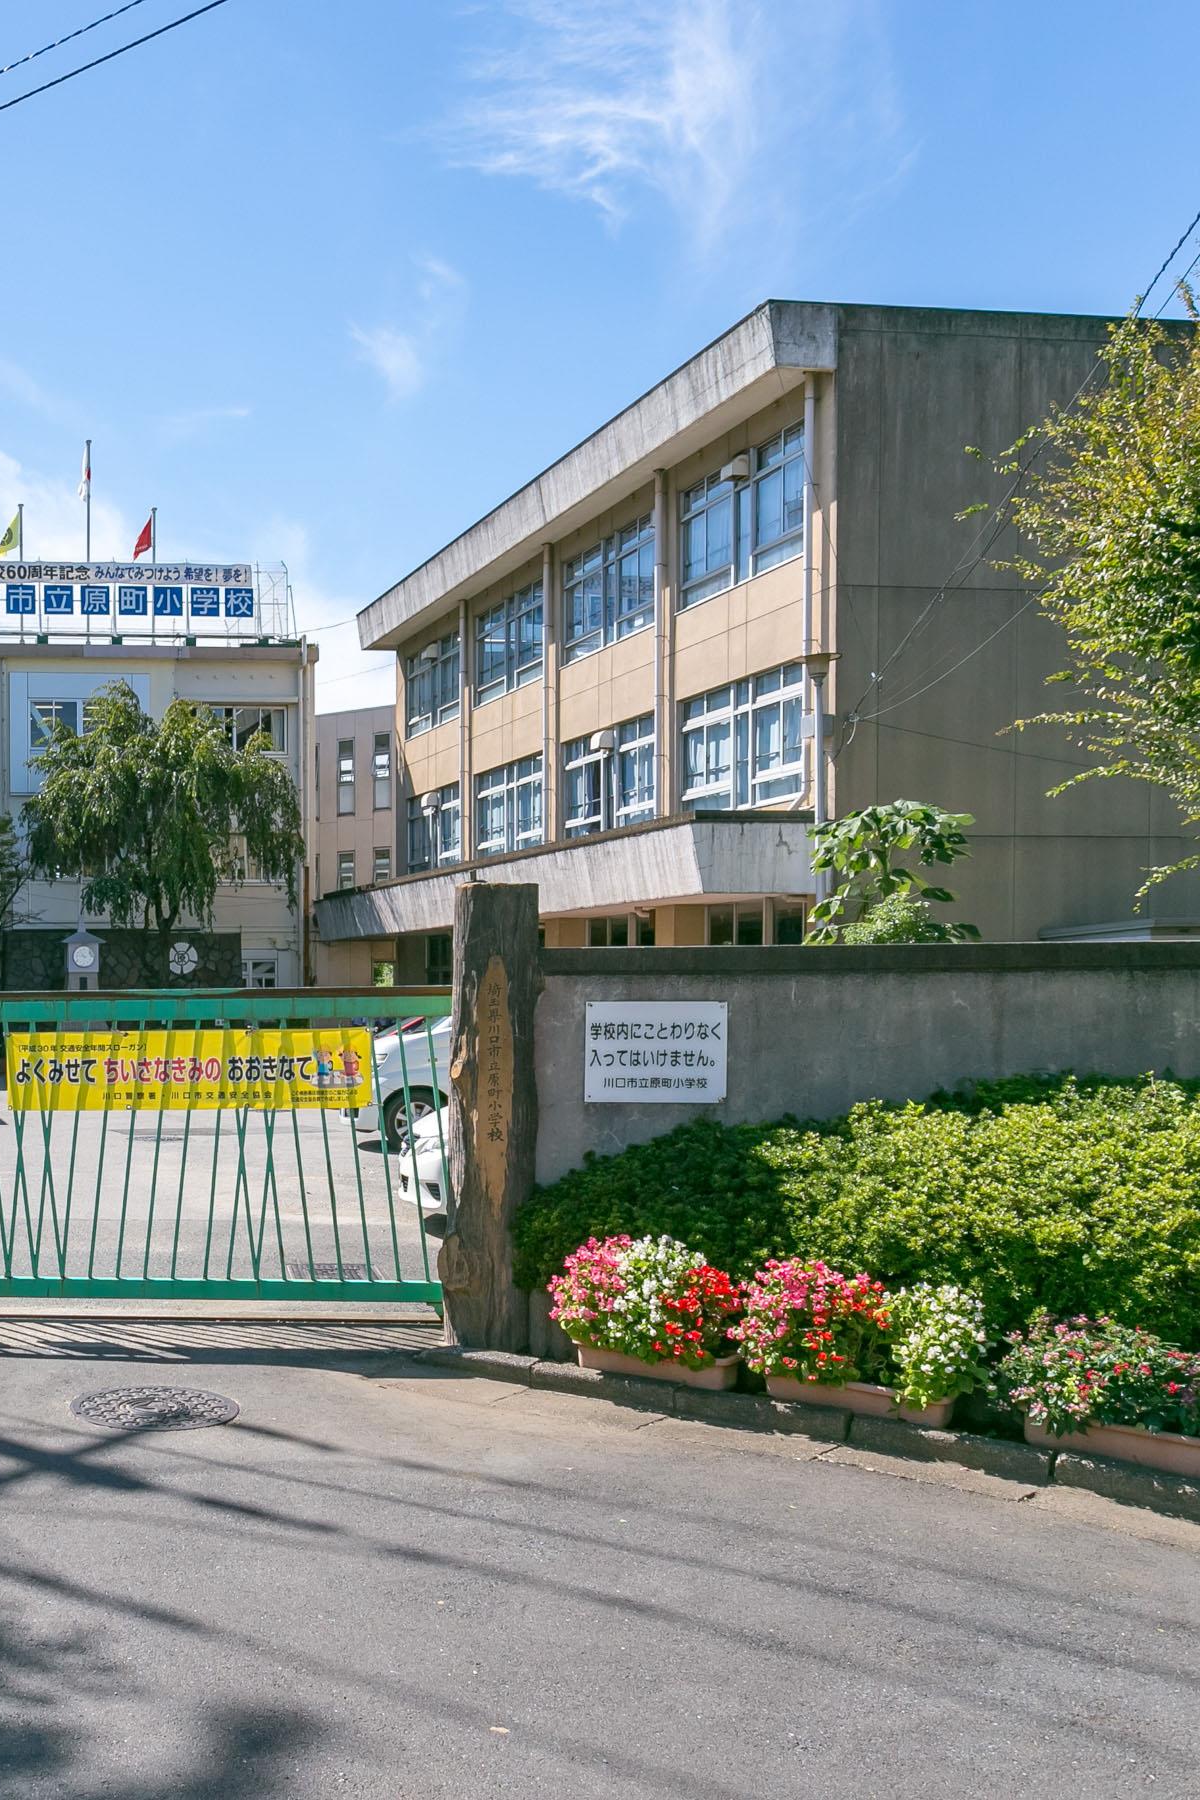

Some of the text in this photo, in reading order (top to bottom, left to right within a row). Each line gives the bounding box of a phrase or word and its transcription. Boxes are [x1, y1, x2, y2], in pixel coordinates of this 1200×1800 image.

[94, 566, 181, 581] みんなでみつけよう
[590, 1022, 721, 1041] 学校内にことわりなく
[487, 983, 505, 1142] 埼玉県川口市立原町小学校
[589, 1049, 715, 1068] 入ってはいけません。
[15, 1055, 313, 1084] よくみせて ちいさなきみの おおきなて
[603, 1077, 708, 1089] 川口市立原町小学校
